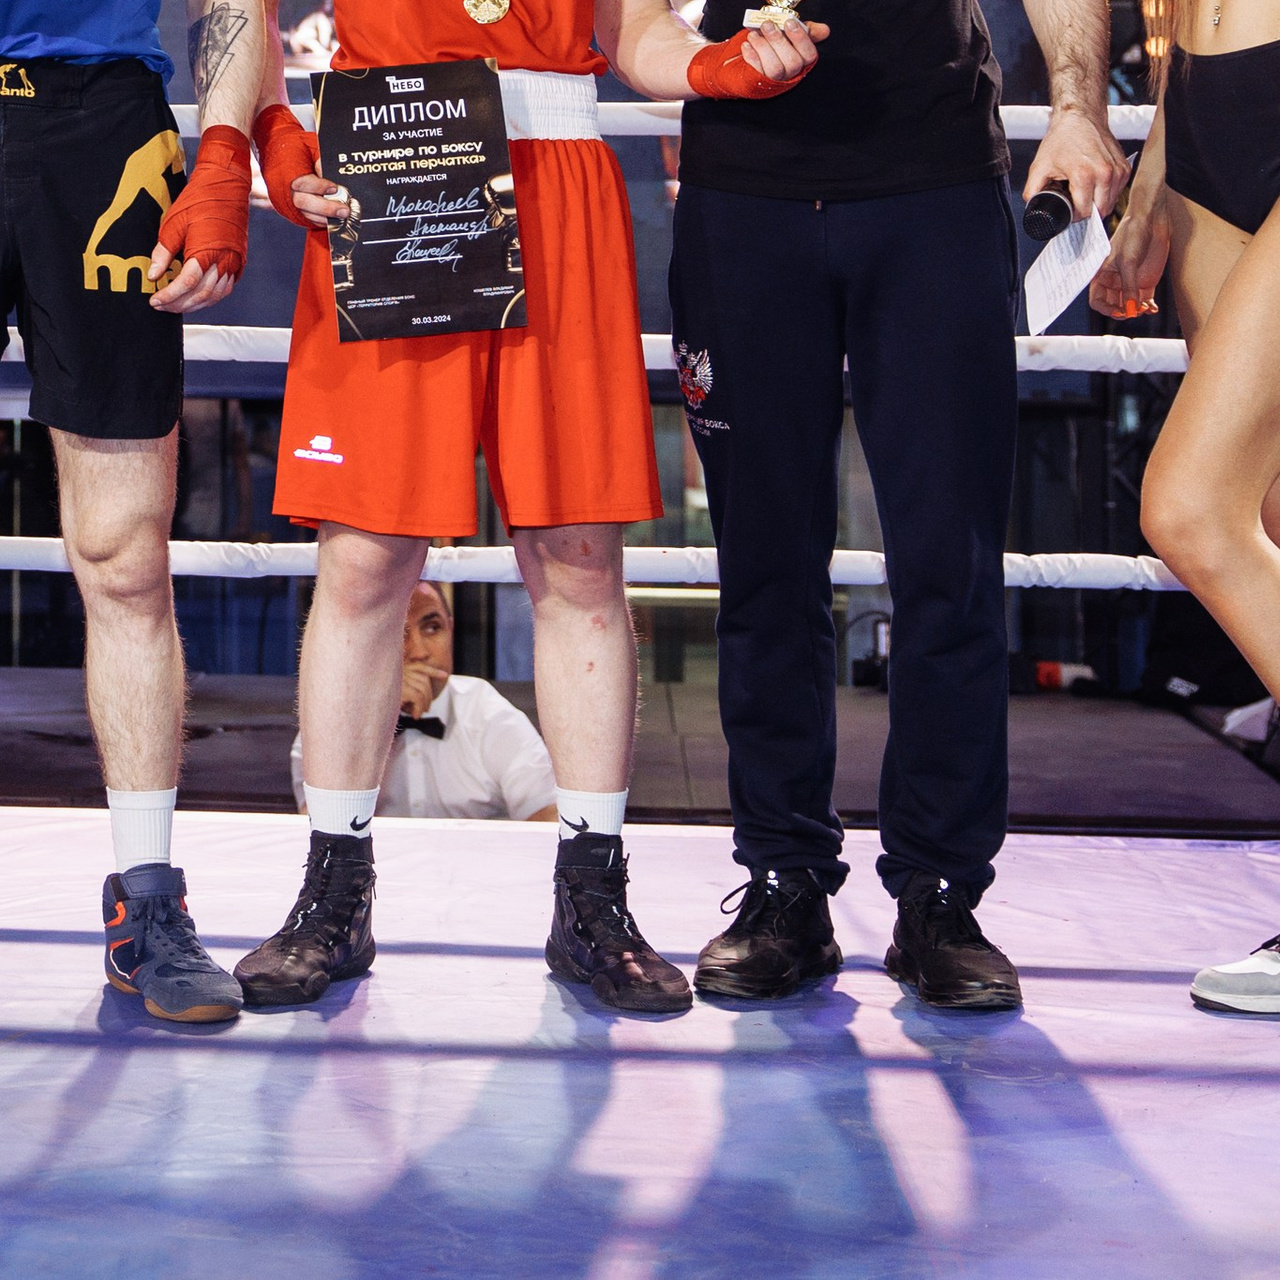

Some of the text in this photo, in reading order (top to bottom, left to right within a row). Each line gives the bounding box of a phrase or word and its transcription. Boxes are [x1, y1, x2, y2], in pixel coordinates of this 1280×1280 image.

[392, 79, 423, 91] НЕБО
[352, 98, 467, 132] ДИПЛОМ
[382, 127, 444, 141] ЗА УЧАСТИЕ
[351, 146, 415, 163] турнире
[419, 144, 437, 156] по
[441, 141, 483, 154] боксу
[338, 155, 487, 176] «Золотая перчатка»
[386, 173, 448, 186] НАГРАЖДАЕТСЯ
[412, 315, 451, 326] 30.03.2024
